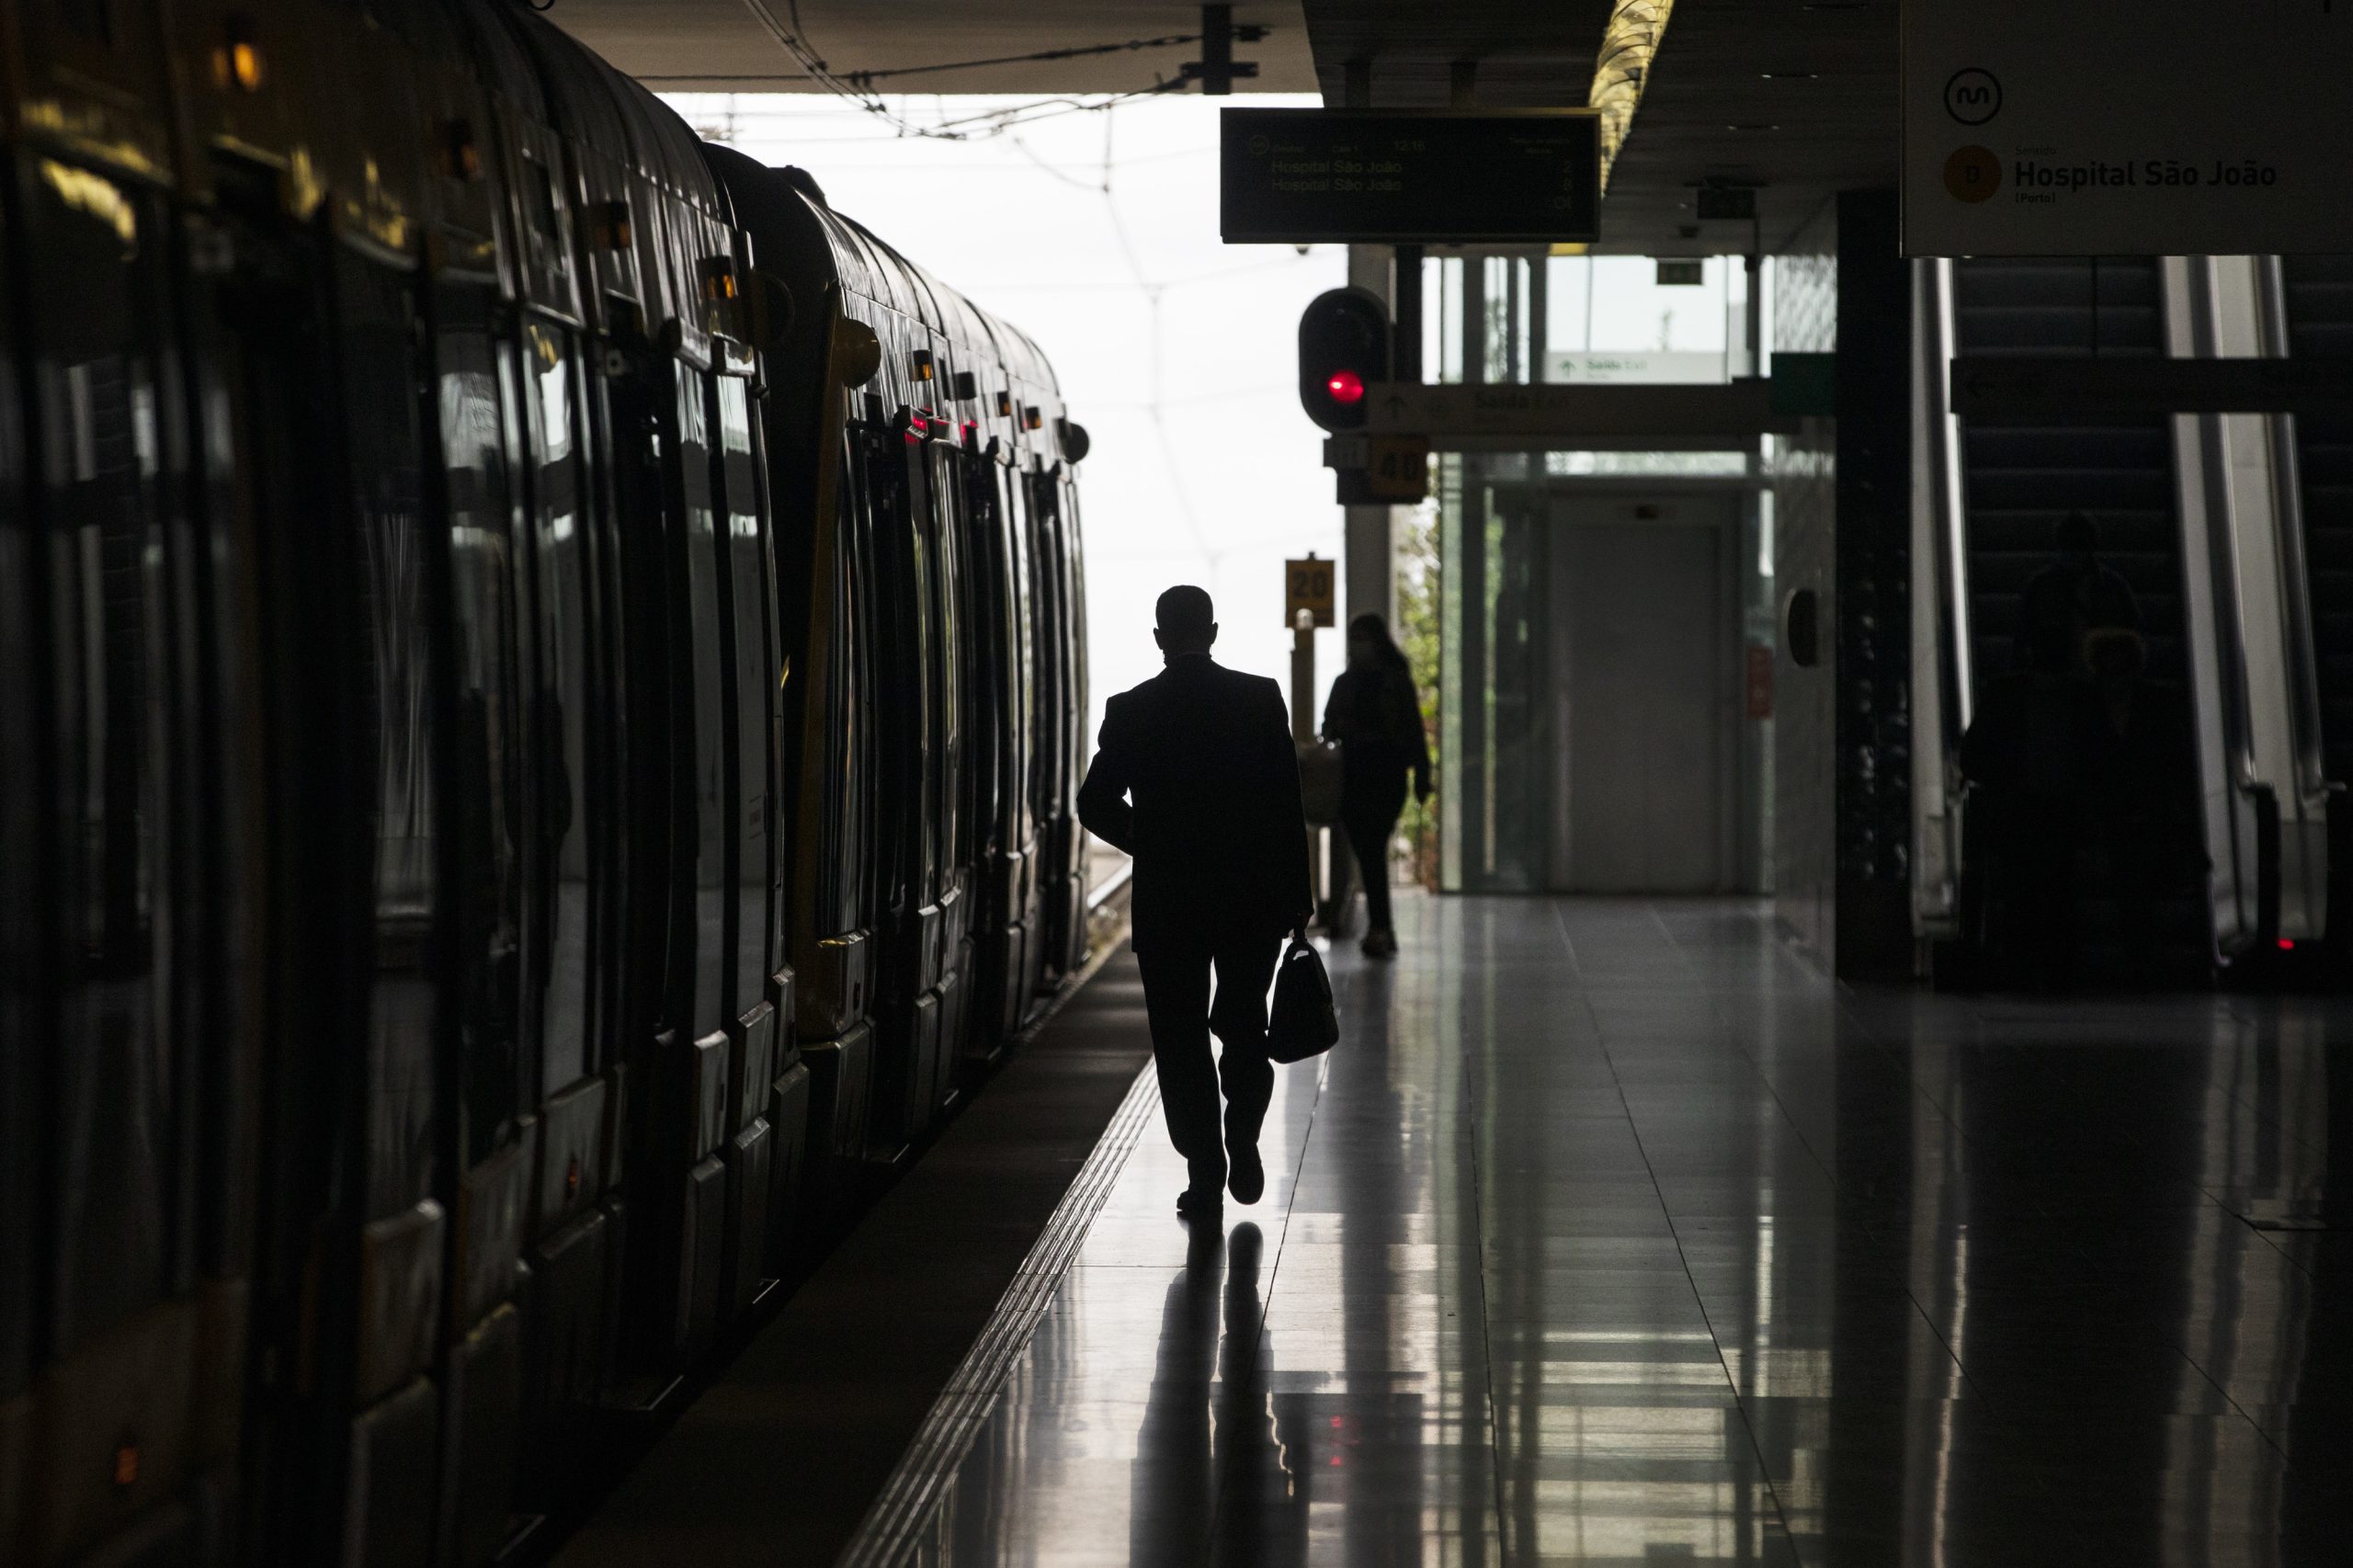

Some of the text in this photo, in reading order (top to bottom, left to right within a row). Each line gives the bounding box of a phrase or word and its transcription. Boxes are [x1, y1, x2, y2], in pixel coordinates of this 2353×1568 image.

[2015, 144, 2057, 155] Sentido
[1271, 159, 1403, 175] Hospital São João
[2016, 159, 2277, 192] Hospital São João
[1271, 177, 1403, 193] Hospital São João
[2016, 192, 2056, 203] (Porto)
[1380, 451, 1419, 480] 40
[1293, 570, 1328, 597] 20
